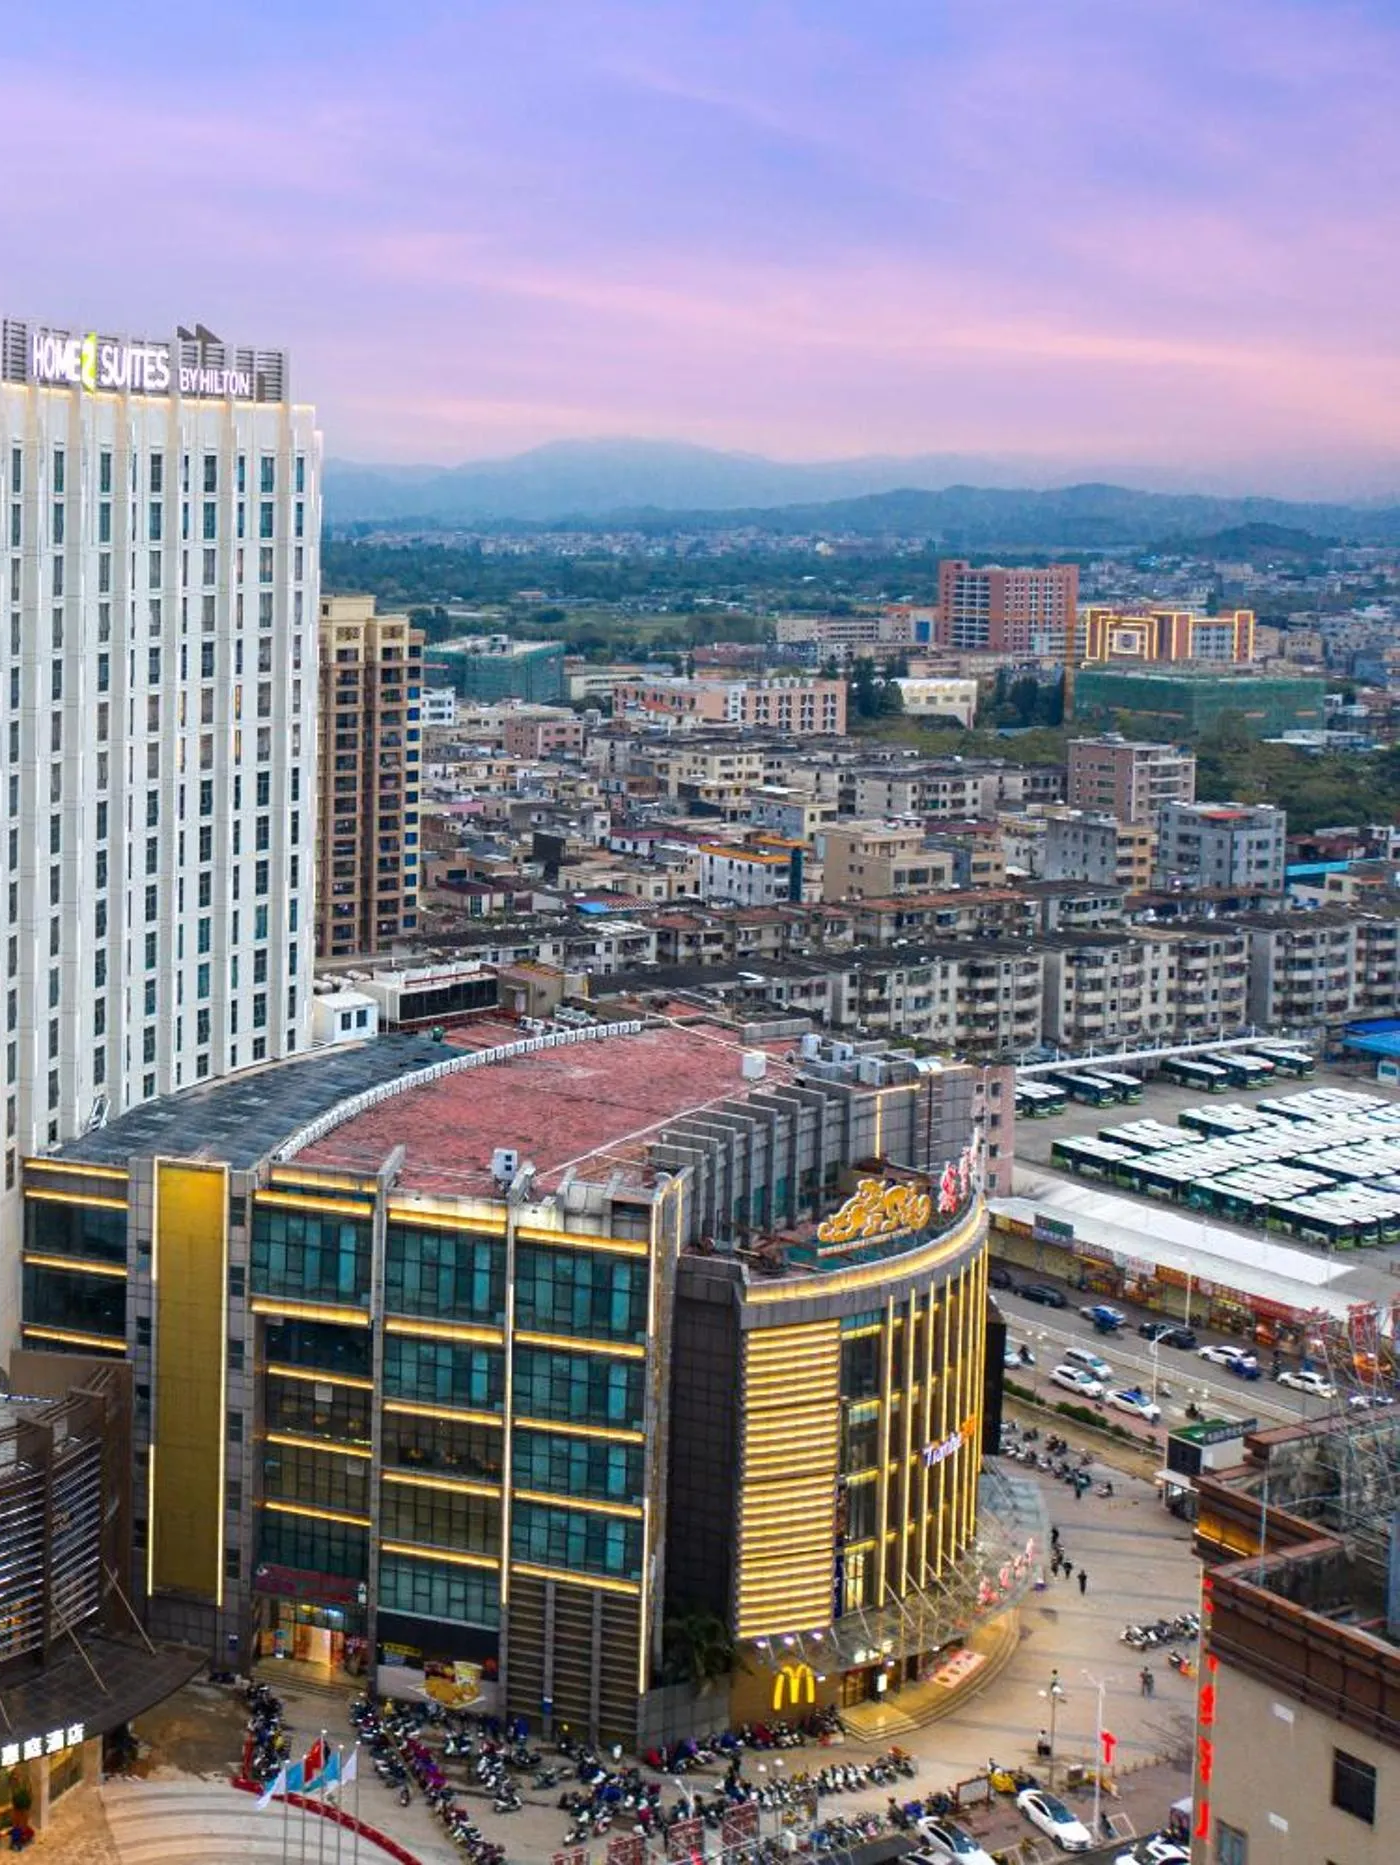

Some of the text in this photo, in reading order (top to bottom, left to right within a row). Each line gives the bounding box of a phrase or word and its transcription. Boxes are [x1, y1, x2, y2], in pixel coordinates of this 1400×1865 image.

[100, 345, 170, 389] SUITES
[178, 366, 199, 393] BY
[200, 367, 250, 395] HILTON
